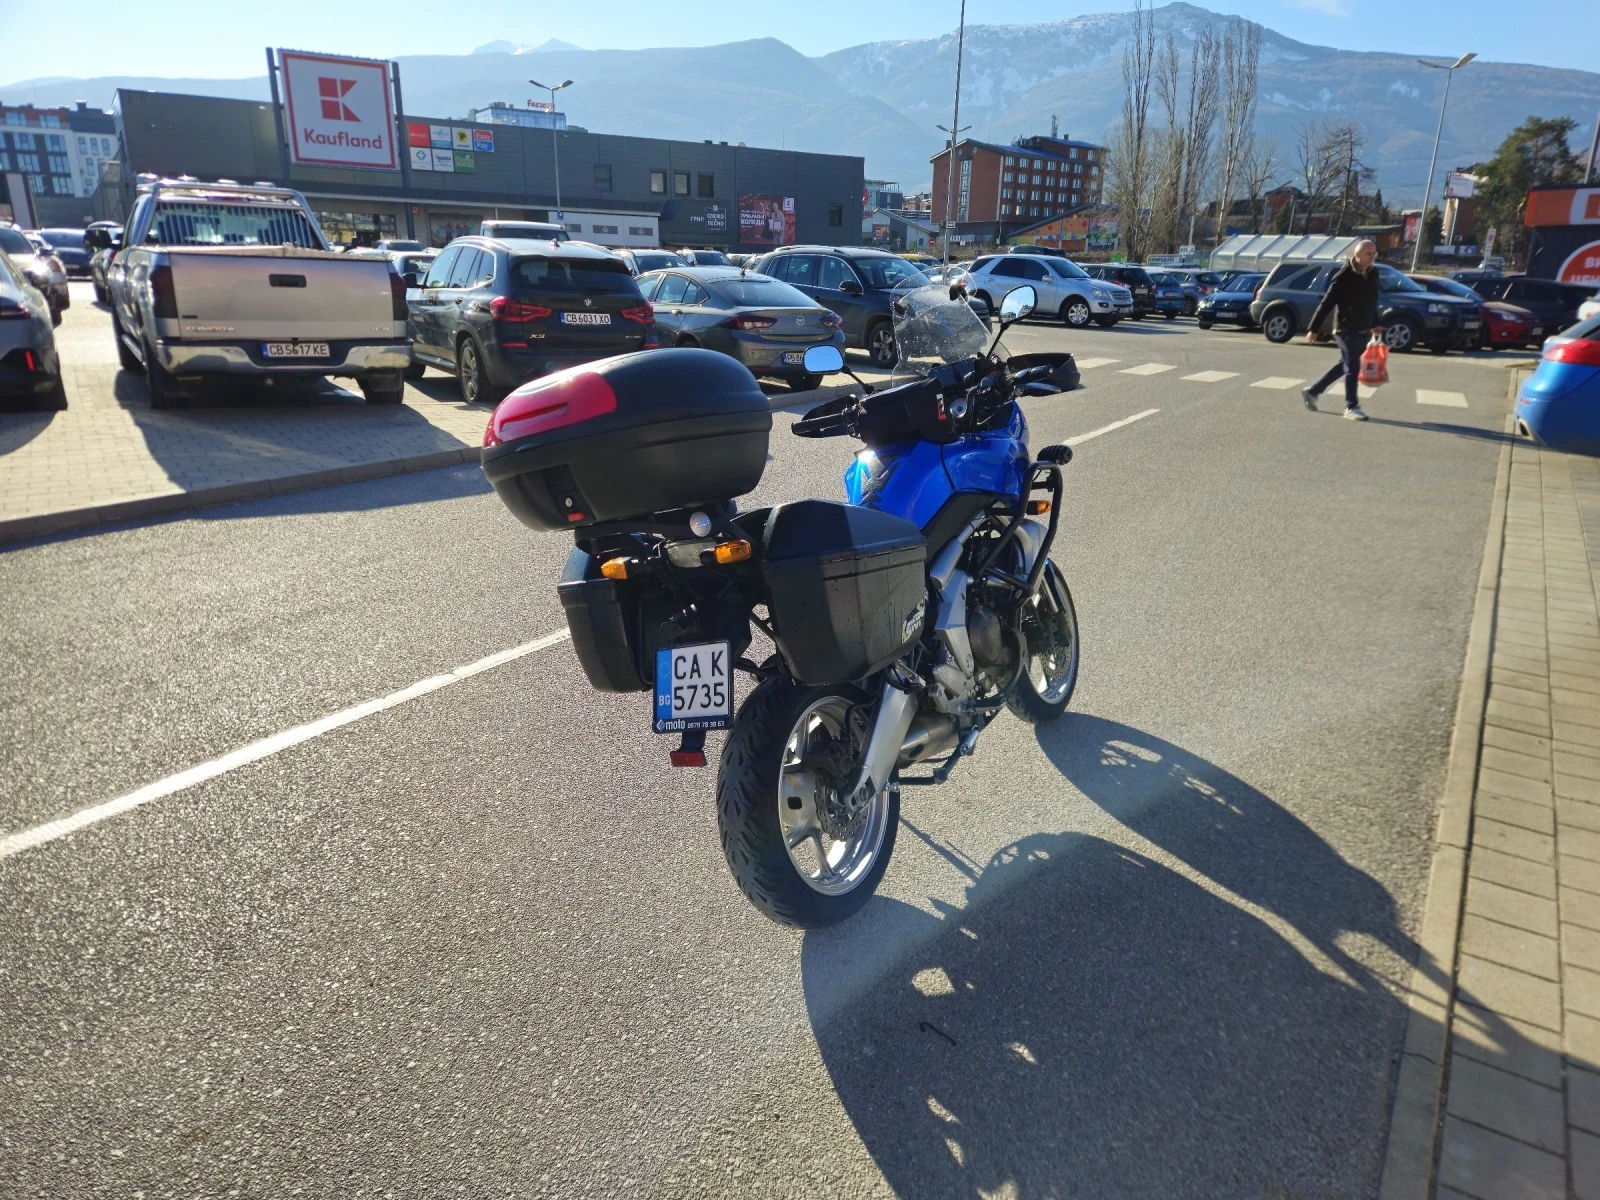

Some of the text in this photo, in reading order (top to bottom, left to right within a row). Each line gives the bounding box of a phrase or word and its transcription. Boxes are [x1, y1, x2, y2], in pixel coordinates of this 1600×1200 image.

[303, 127, 383, 150] Kaufland
[475, 132, 491, 141] Easy
[476, 142, 488, 151] Pay
[566, 313, 610, 324] CB 6031 XO
[269, 345, 328, 355] CB 5617 KE
[674, 650, 724, 680] CA K
[659, 695, 671, 706] BG
[674, 682, 726, 711] 5735
[665, 719, 686, 730] moto
